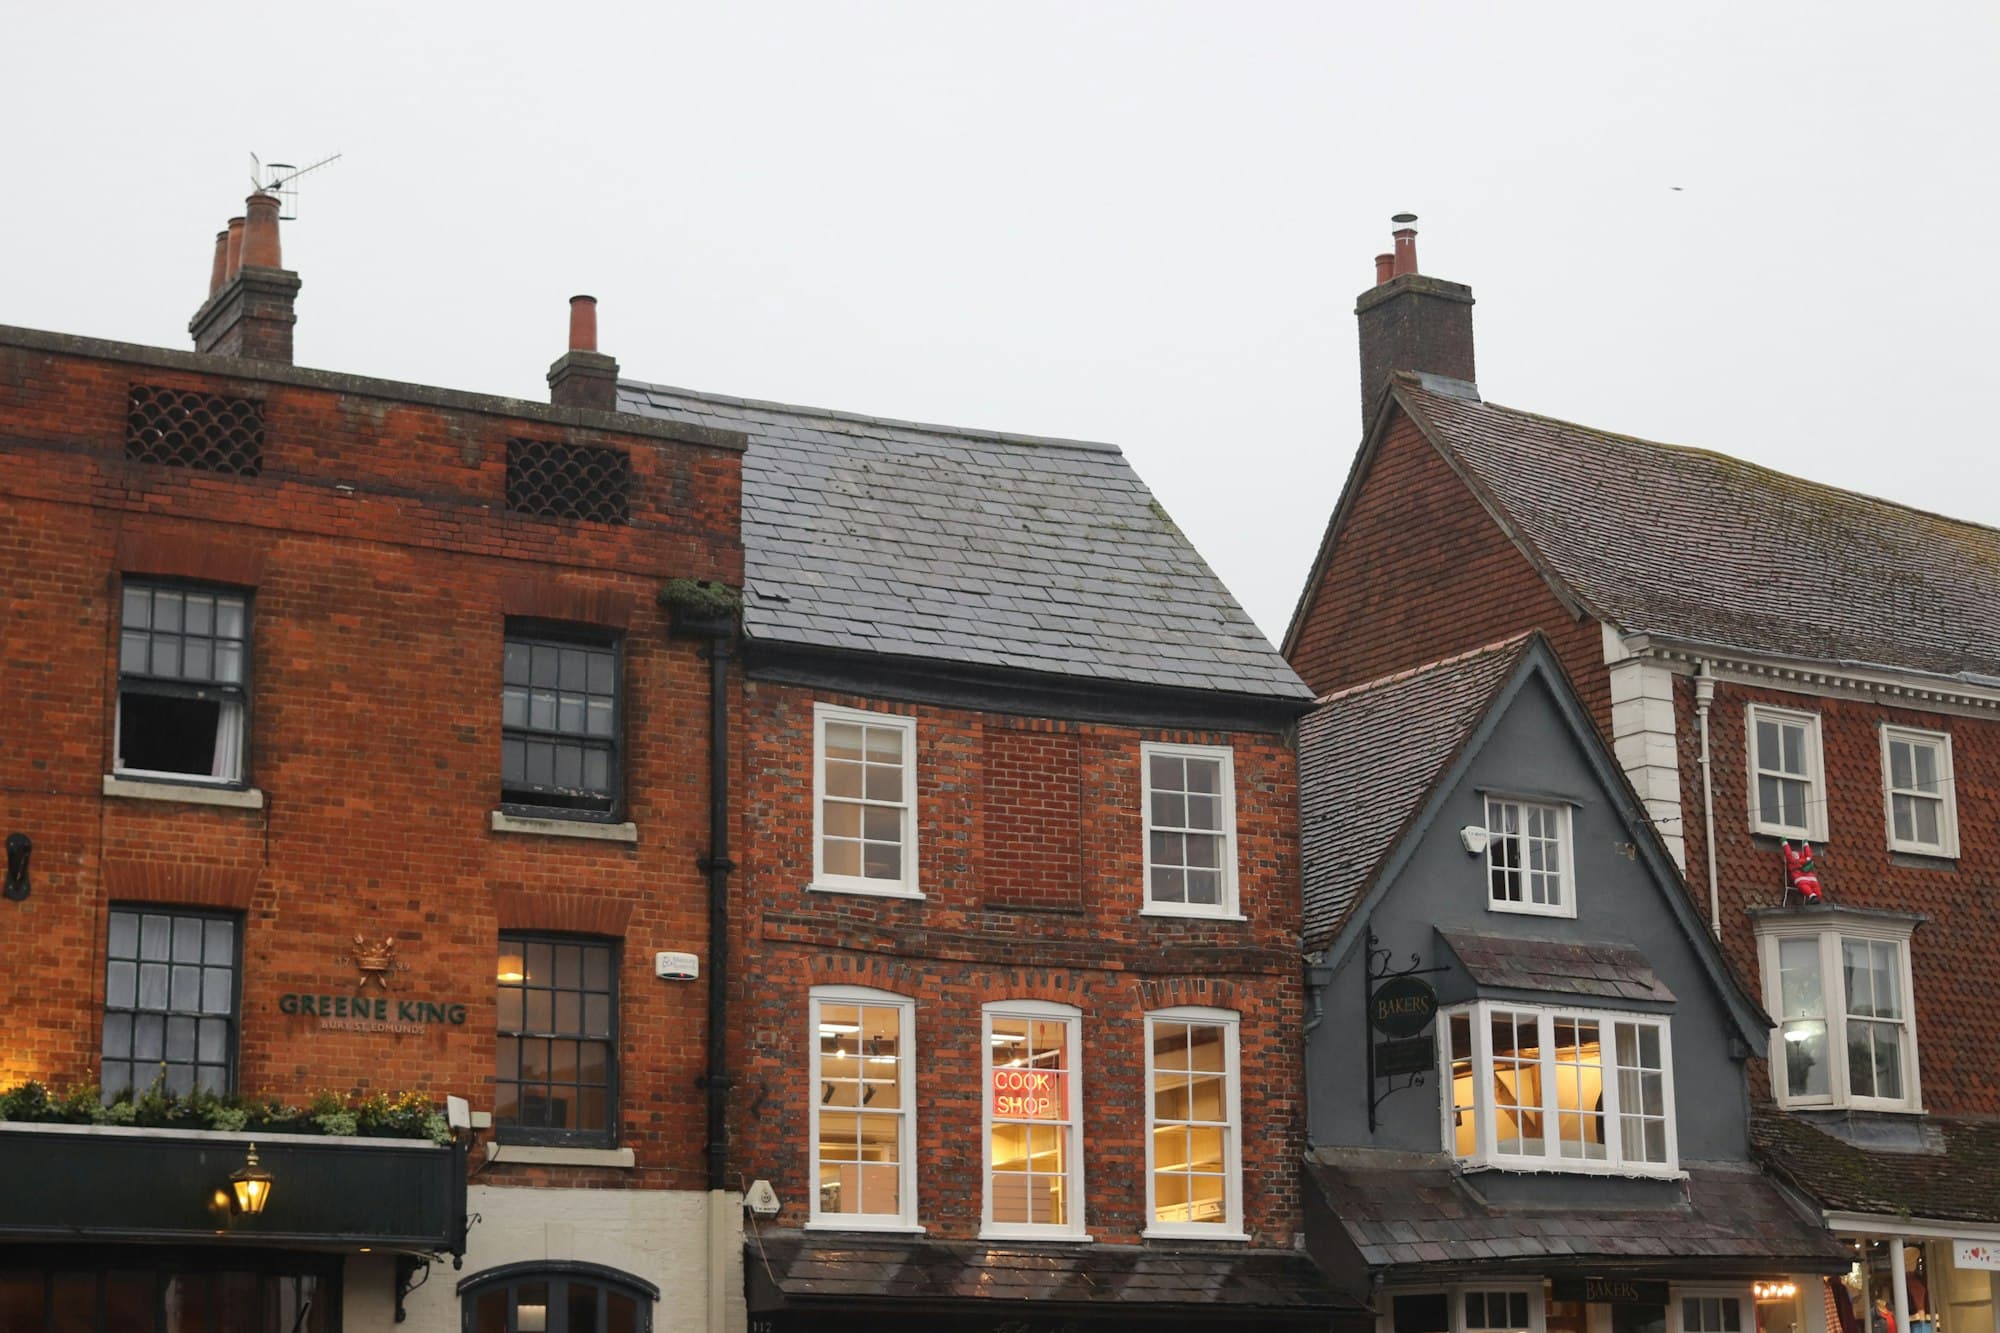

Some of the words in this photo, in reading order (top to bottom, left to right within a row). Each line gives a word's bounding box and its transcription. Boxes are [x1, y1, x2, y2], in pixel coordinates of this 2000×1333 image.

[279, 994, 388, 1021] GREENE
[398, 1000, 467, 1025] KING
[1378, 996, 1430, 1020] BAKERS
[371, 1022, 425, 1034] EDMUNDS
[995, 1071, 1050, 1091] COOK
[997, 1095, 1050, 1114] SHOP
[1585, 1280, 1640, 1301] BAKERS
